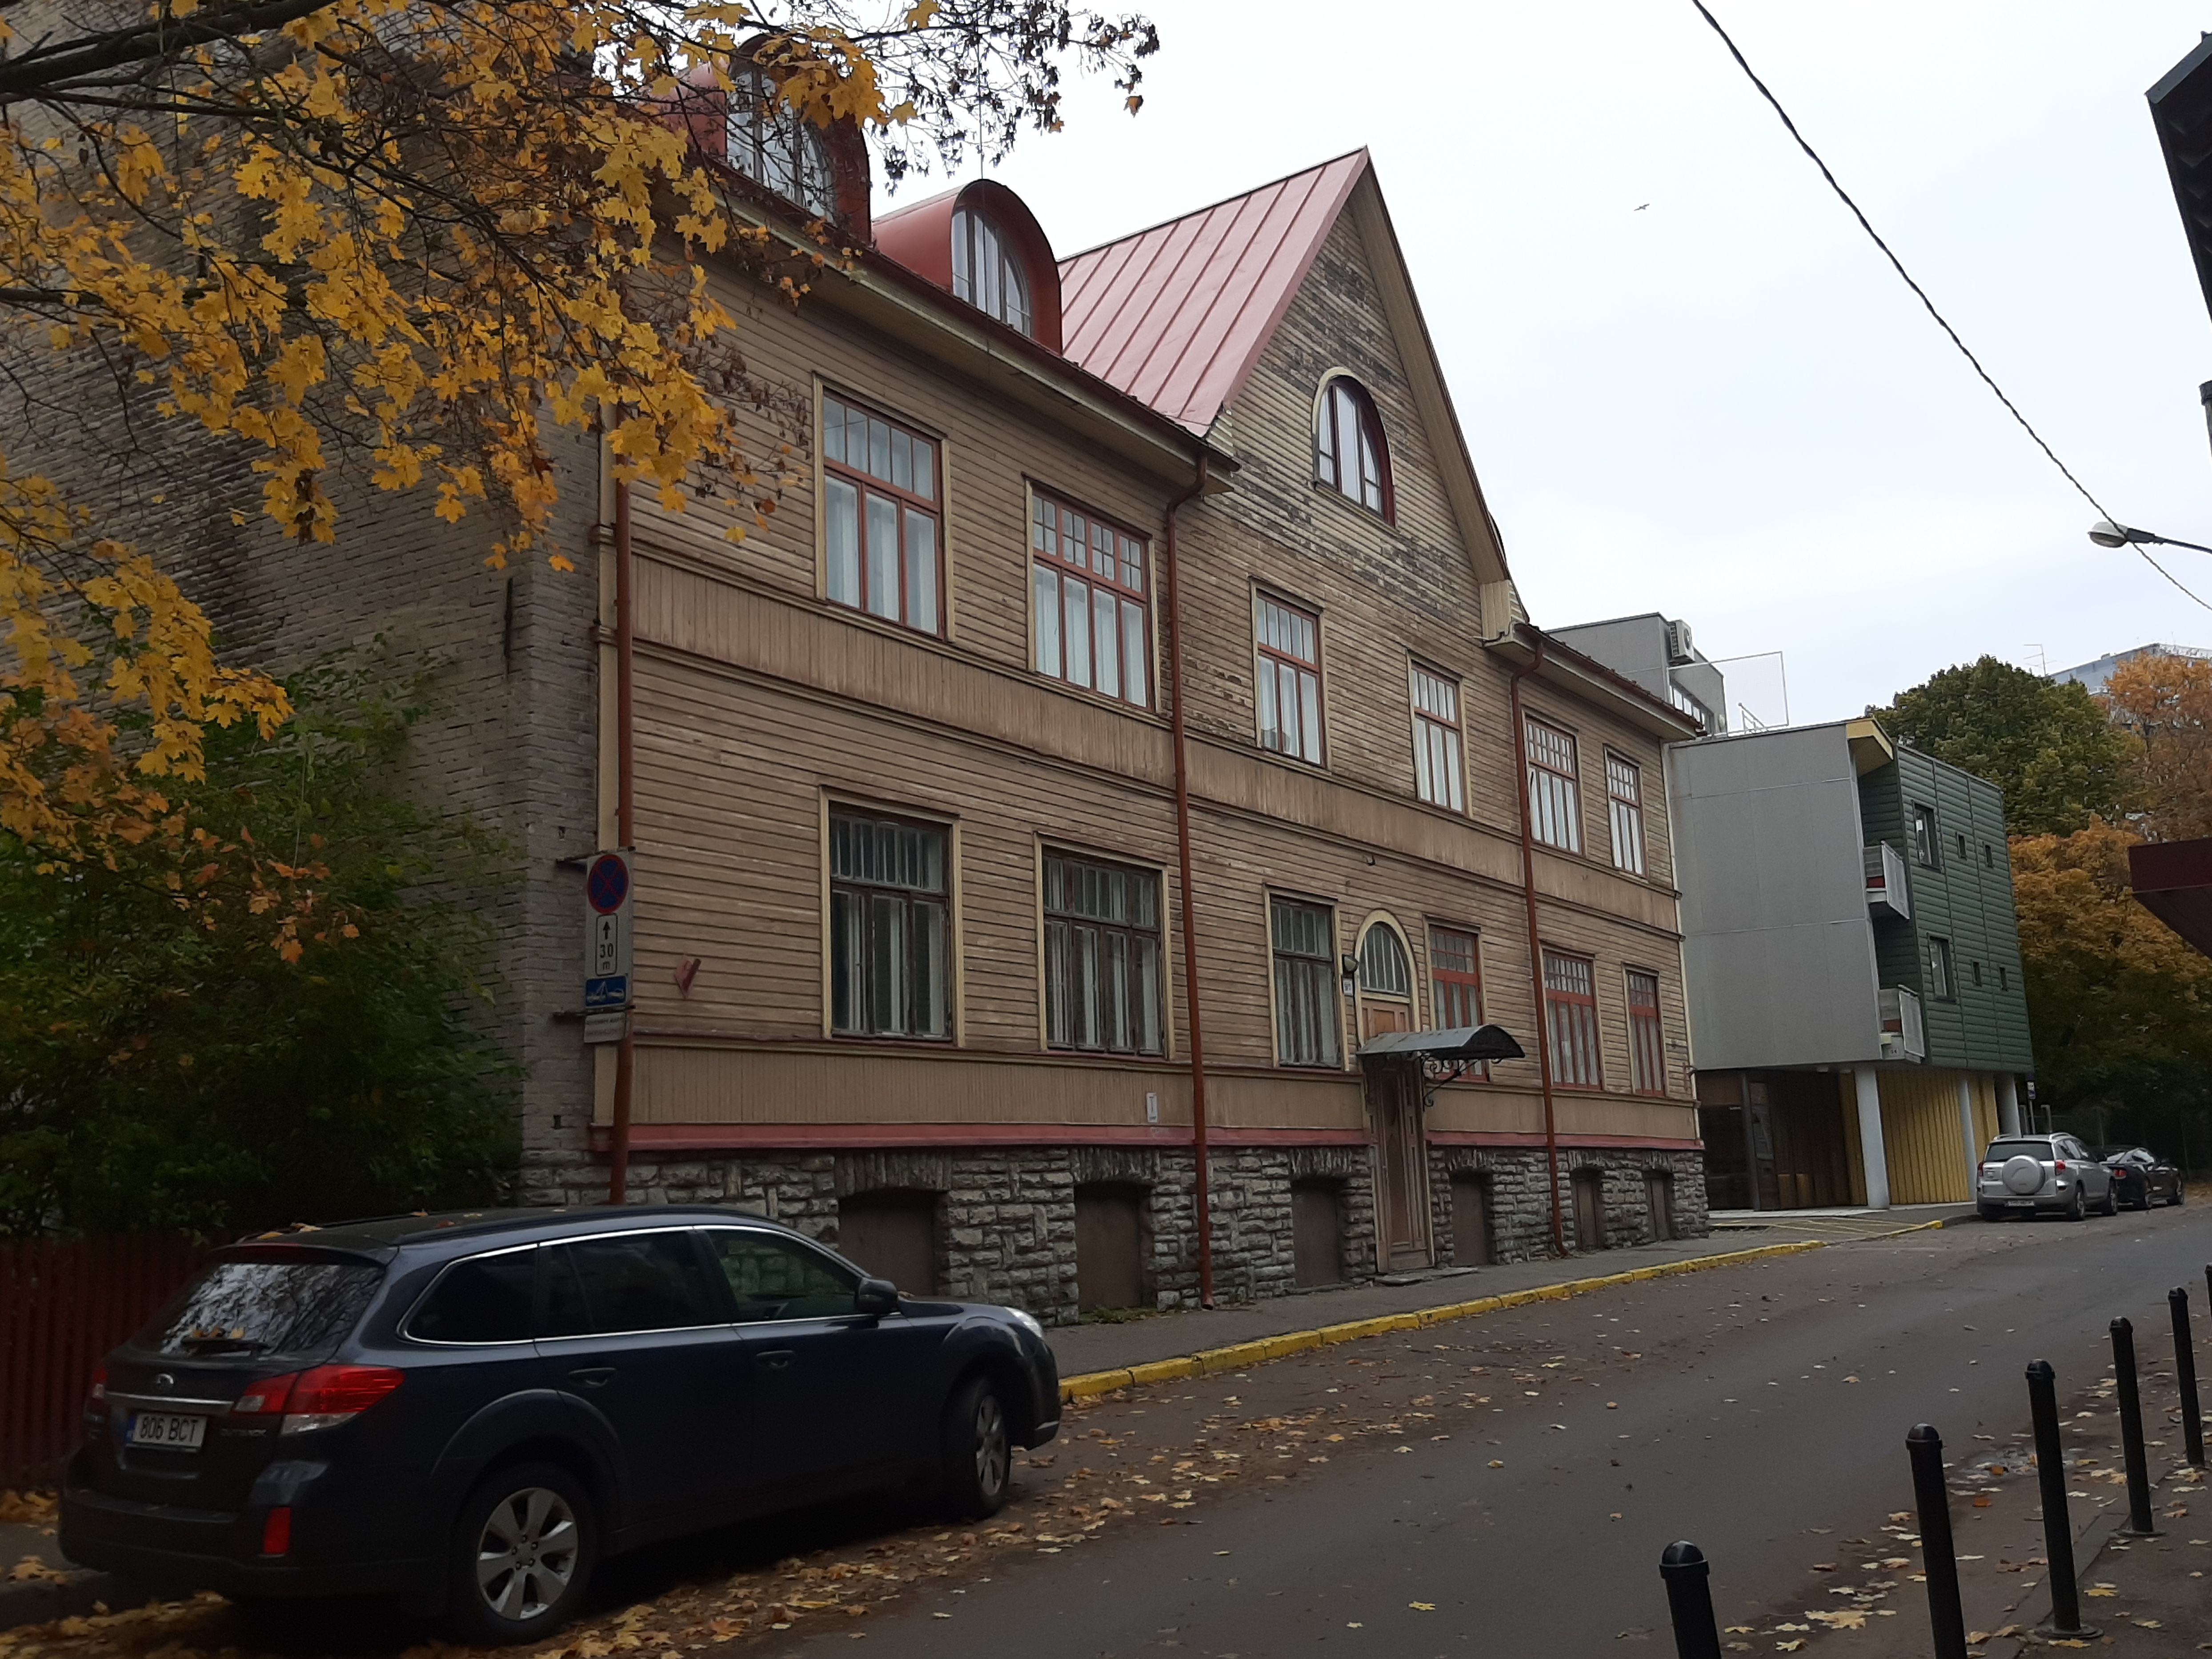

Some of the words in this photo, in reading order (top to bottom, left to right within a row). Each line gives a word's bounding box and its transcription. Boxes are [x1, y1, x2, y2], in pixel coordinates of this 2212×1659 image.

[600, 943, 613, 958] 30
[602, 961, 610, 971] m
[140, 1415, 165, 1440] 806
[168, 1417, 198, 1442] BCT
